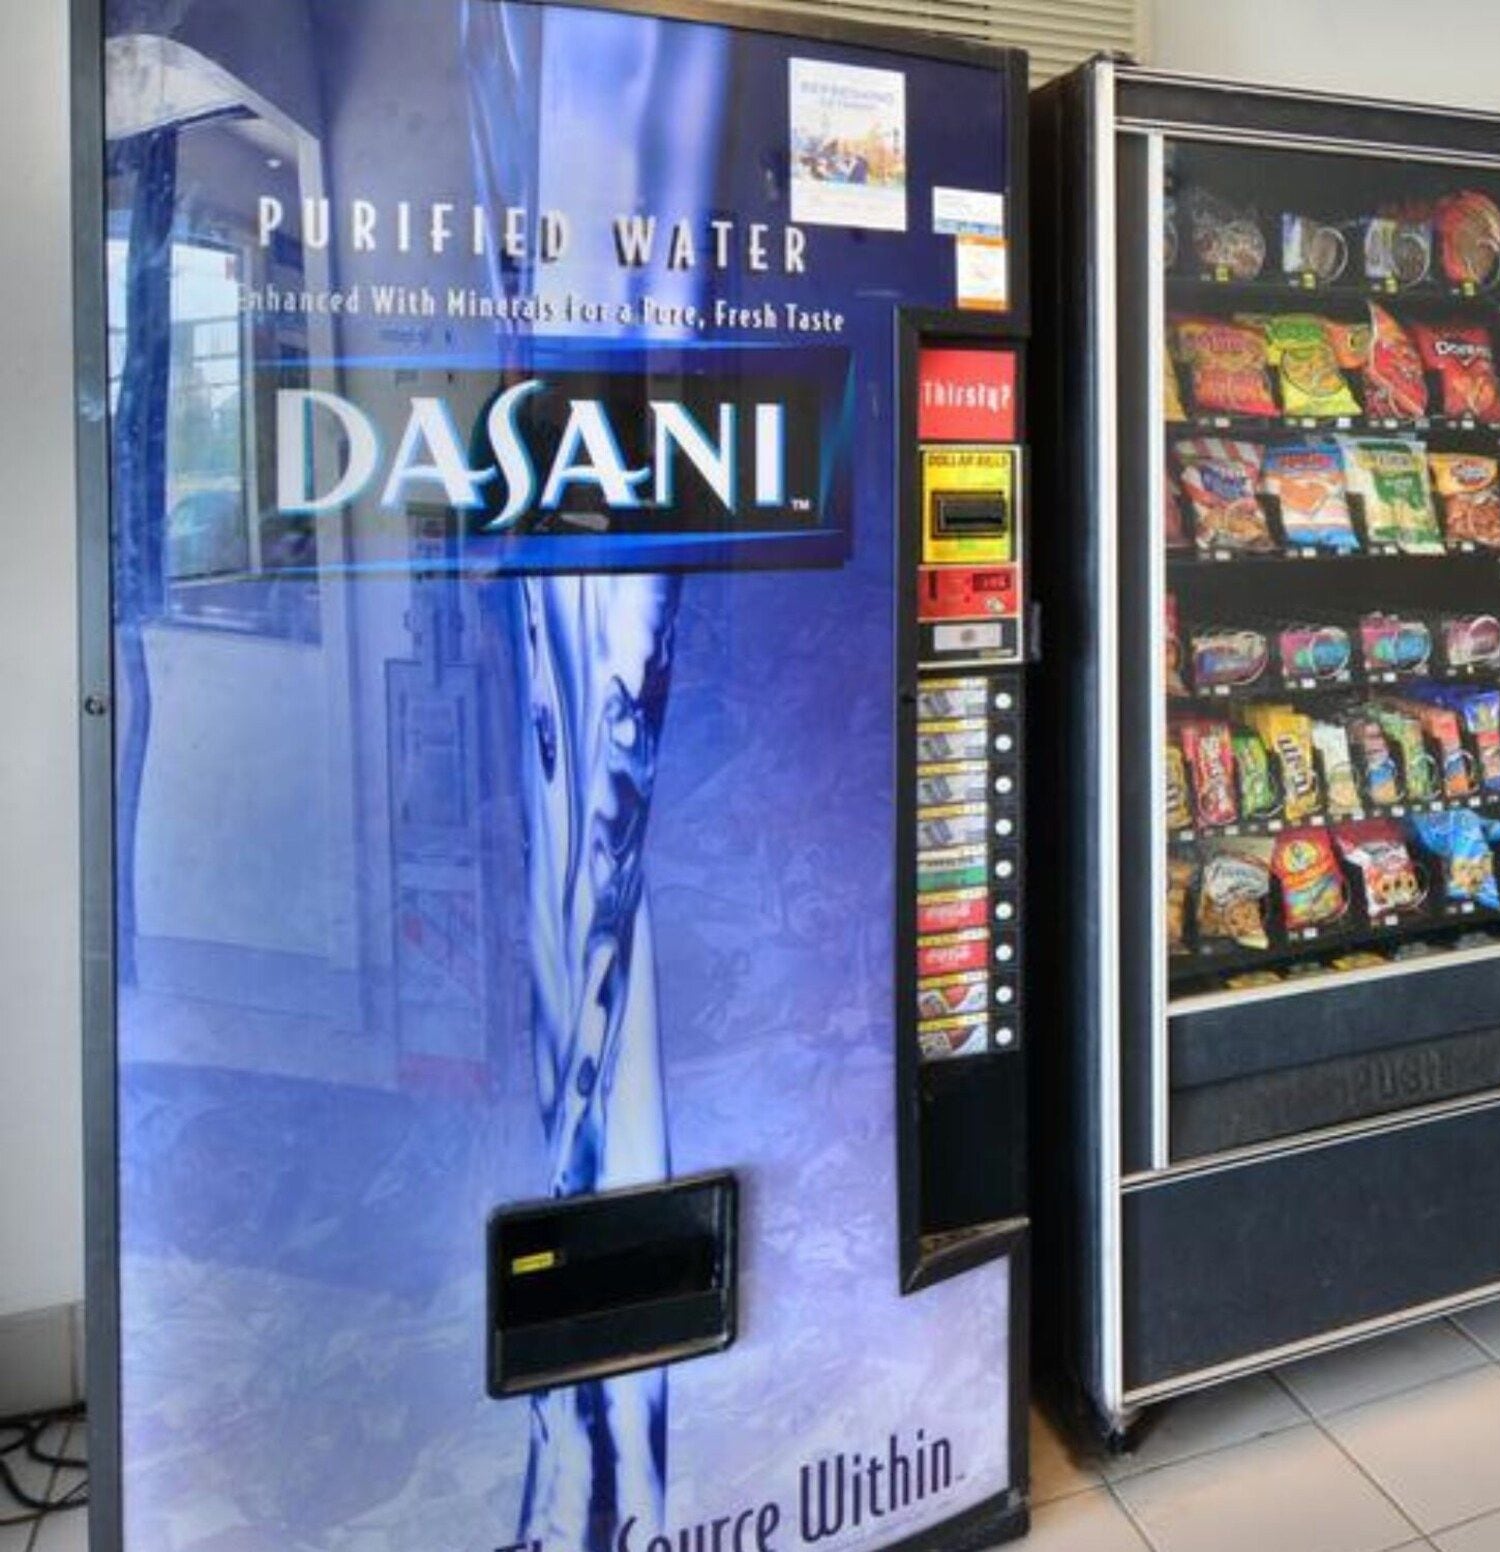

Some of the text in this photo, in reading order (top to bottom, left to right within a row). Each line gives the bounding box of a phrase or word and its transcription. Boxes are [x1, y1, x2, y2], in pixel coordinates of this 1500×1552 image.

[258, 196, 807, 273] PURIFIED WATER
[241, 283, 359, 314] Enhanced
[371, 285, 435, 317] With
[448, 288, 553, 321] Minerals
[643, 297, 705, 330] Pure,
[714, 299, 777, 329] Fresh
[785, 302, 845, 333] Taste
[924, 379, 1011, 413] Thirsty?
[276, 379, 788, 532] DASANI
[801, 1428, 951, 1543] Within
